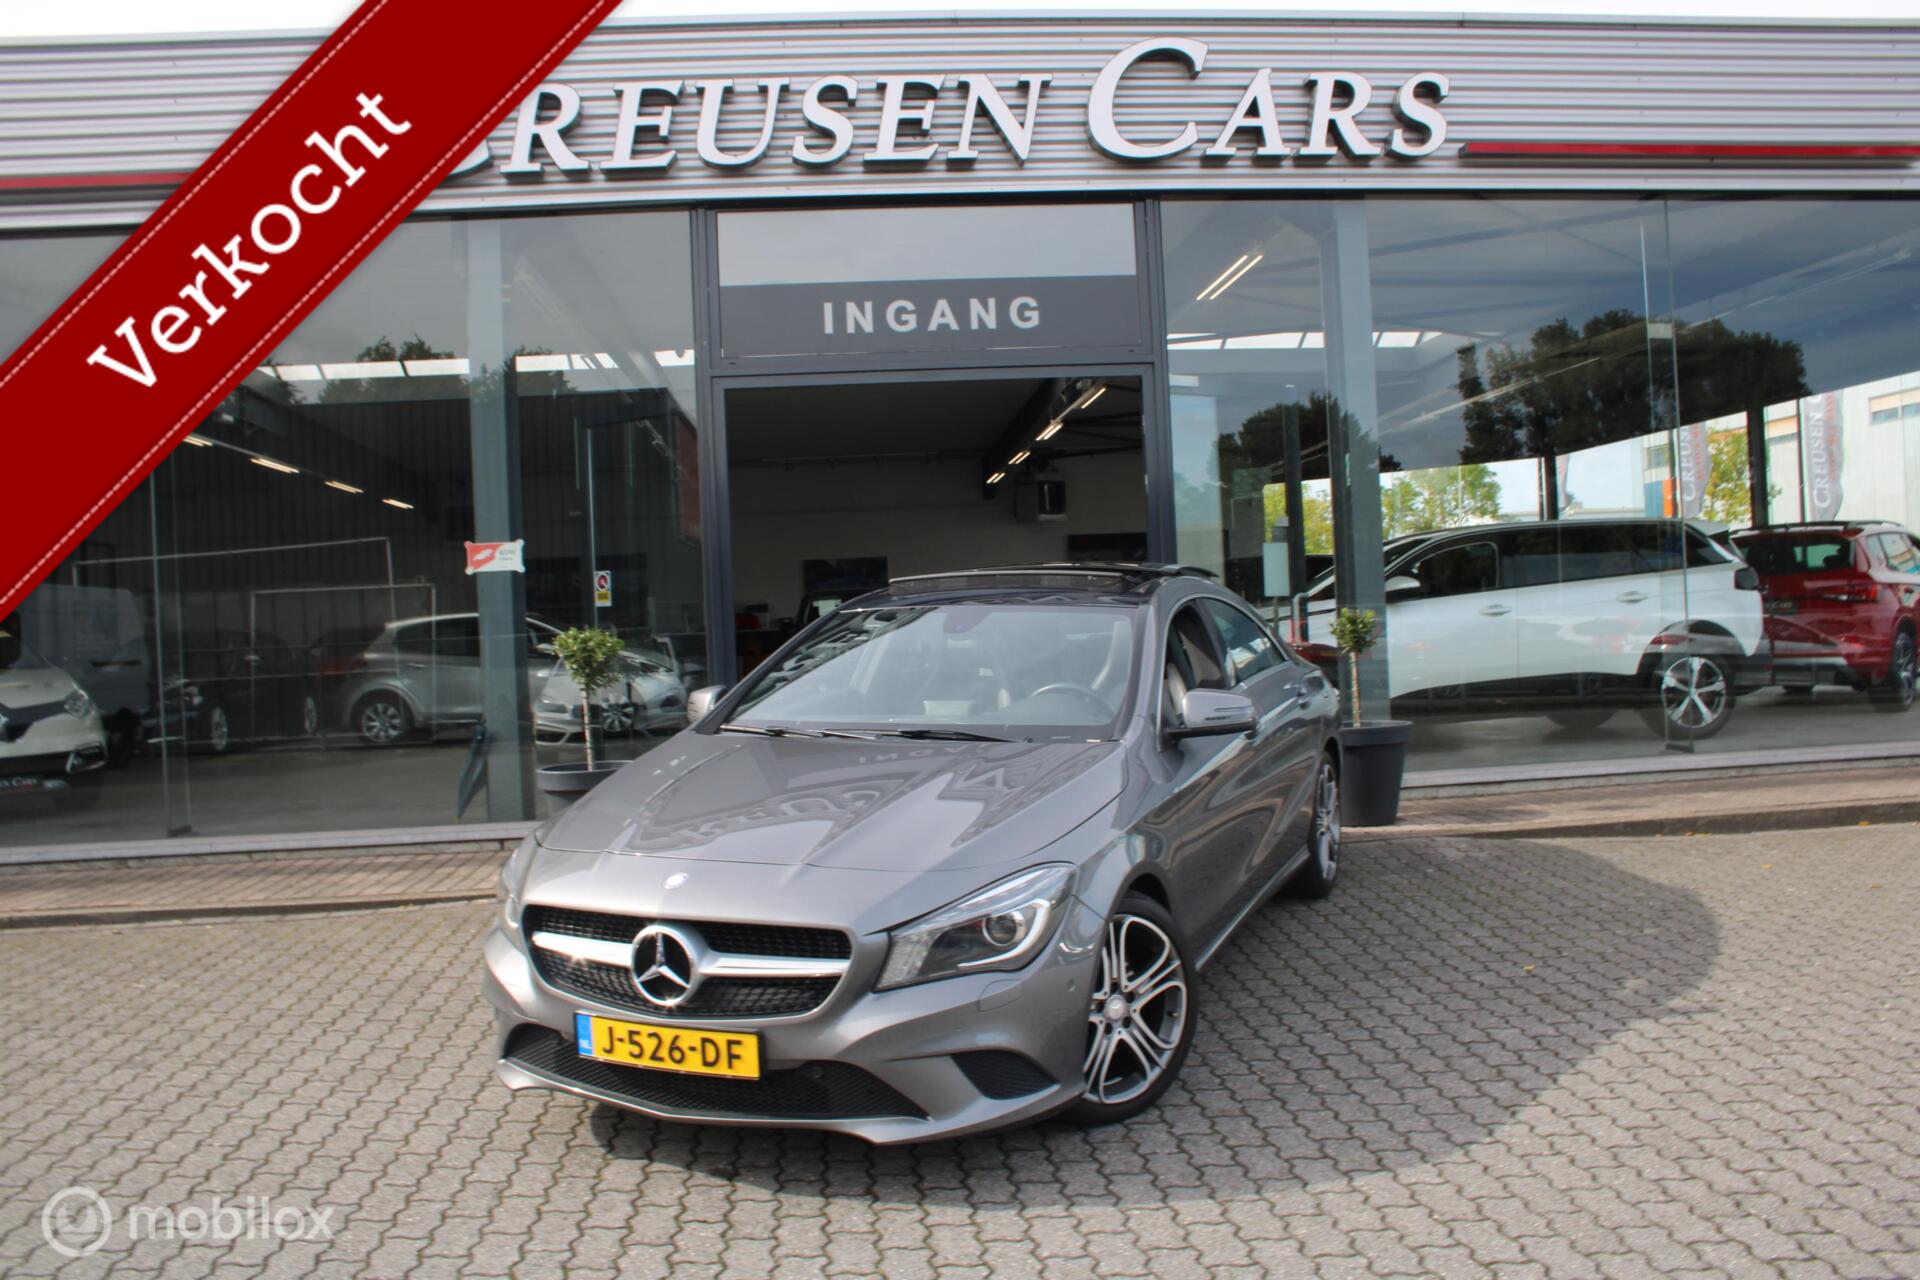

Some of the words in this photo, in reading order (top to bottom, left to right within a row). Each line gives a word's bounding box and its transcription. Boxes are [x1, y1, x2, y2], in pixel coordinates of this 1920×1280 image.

[447, 73, 1053, 175] REUSEN
[1088, 36, 1450, 161] CARS
[823, 296, 1040, 334] INGANG
[1808, 411, 1832, 508] CREUSEN
[602, 1026, 743, 1069] J-526-DF
